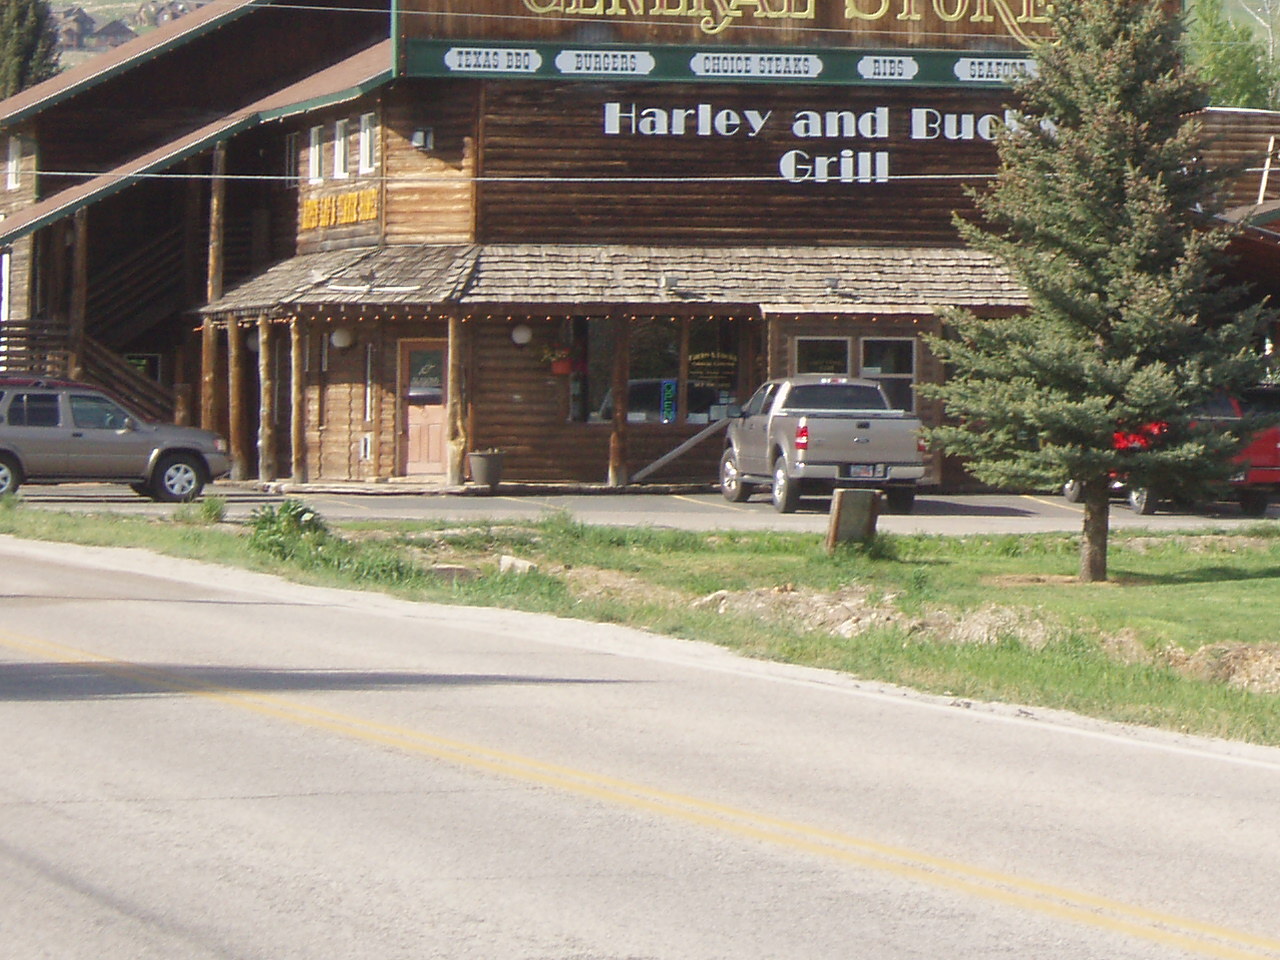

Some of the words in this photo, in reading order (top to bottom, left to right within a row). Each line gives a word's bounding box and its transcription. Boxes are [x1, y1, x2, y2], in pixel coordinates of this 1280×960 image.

[457, 50, 499, 69] TEXAS
[505, 52, 530, 70] BBQ
[574, 53, 637, 72] BURGERS
[703, 56, 751, 74] CHOICE
[759, 57, 810, 75] STEAKS
[872, 59, 904, 77] RIBS
[604, 102, 772, 136] Harley
[792, 107, 889, 138] and
[779, 149, 889, 183] Grill
